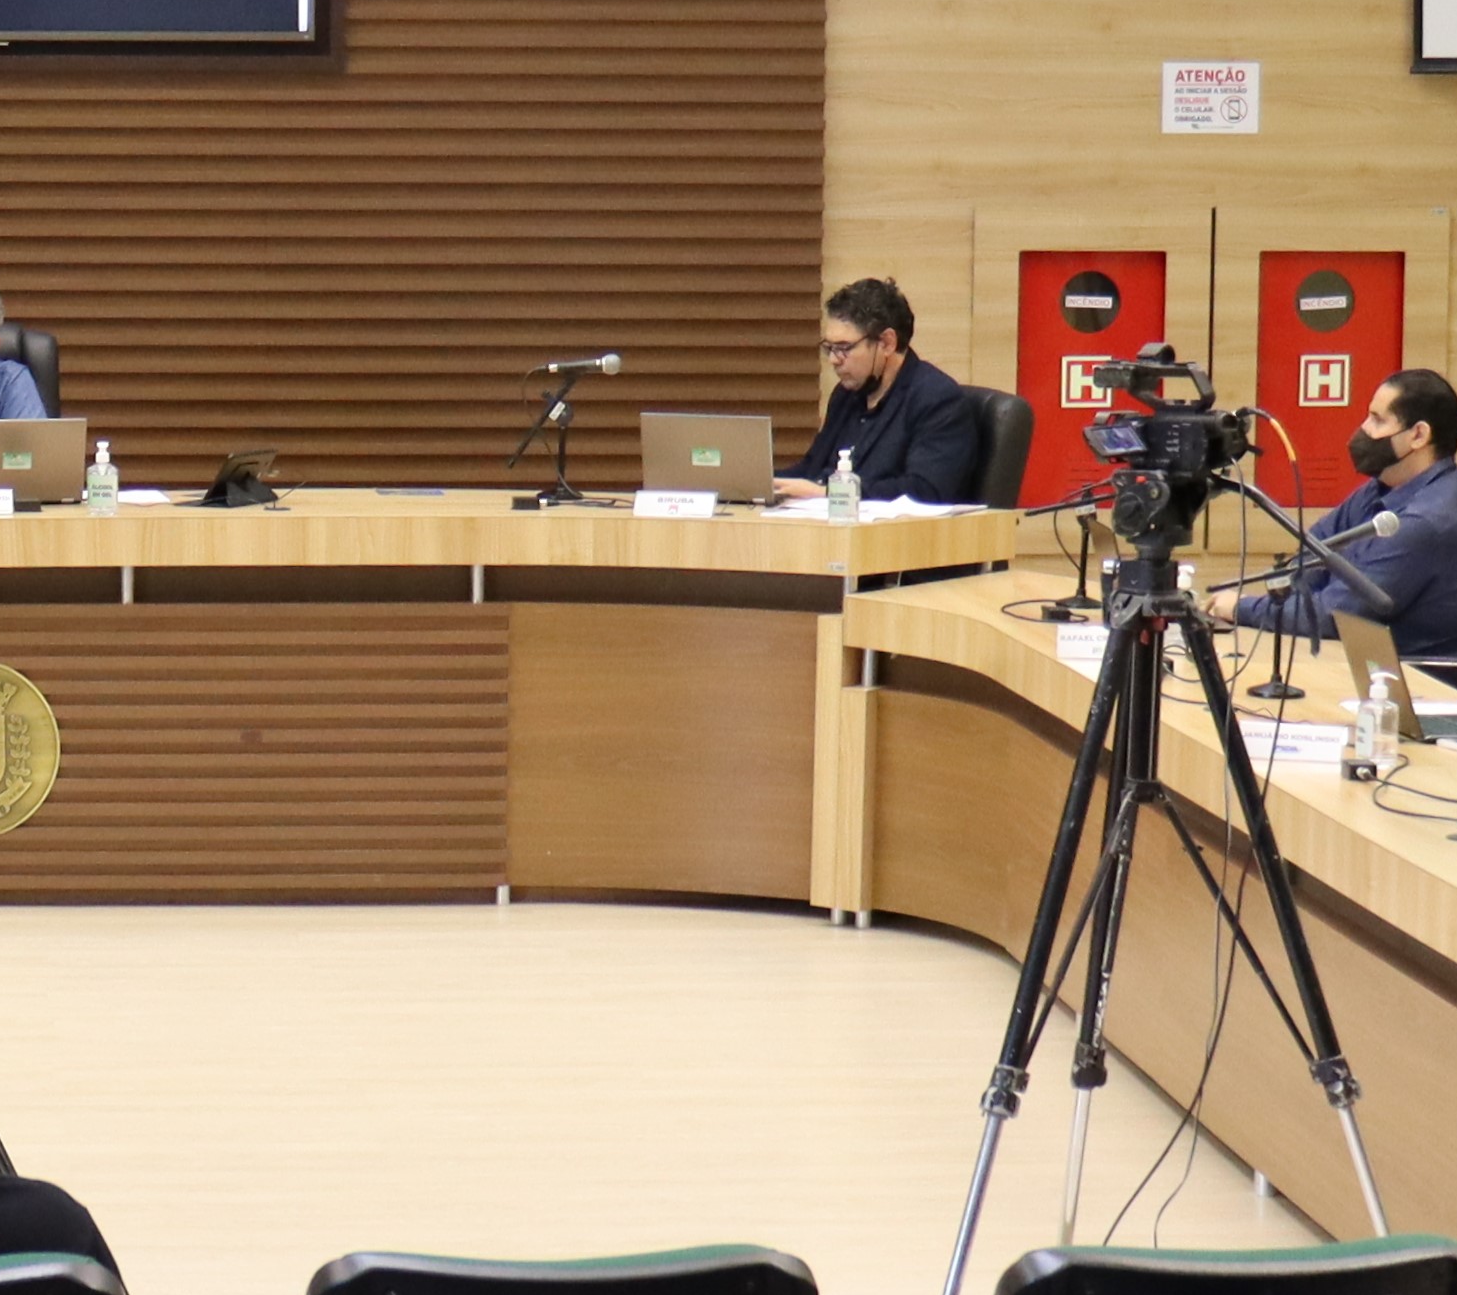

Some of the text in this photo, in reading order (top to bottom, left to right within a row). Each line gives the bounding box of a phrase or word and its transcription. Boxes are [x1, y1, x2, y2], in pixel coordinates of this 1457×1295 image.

[1175, 67, 1246, 85] ATENÇÃO
[1066, 296, 1111, 308] INCÊNDIO
[1301, 297, 1346, 308] INCÊNDIO
[1306, 363, 1341, 400] H
[657, 496, 694, 504] BIRUBA
[1060, 634, 1093, 642] RAFAEL
[1243, 732, 1290, 741] JANUÁIO
